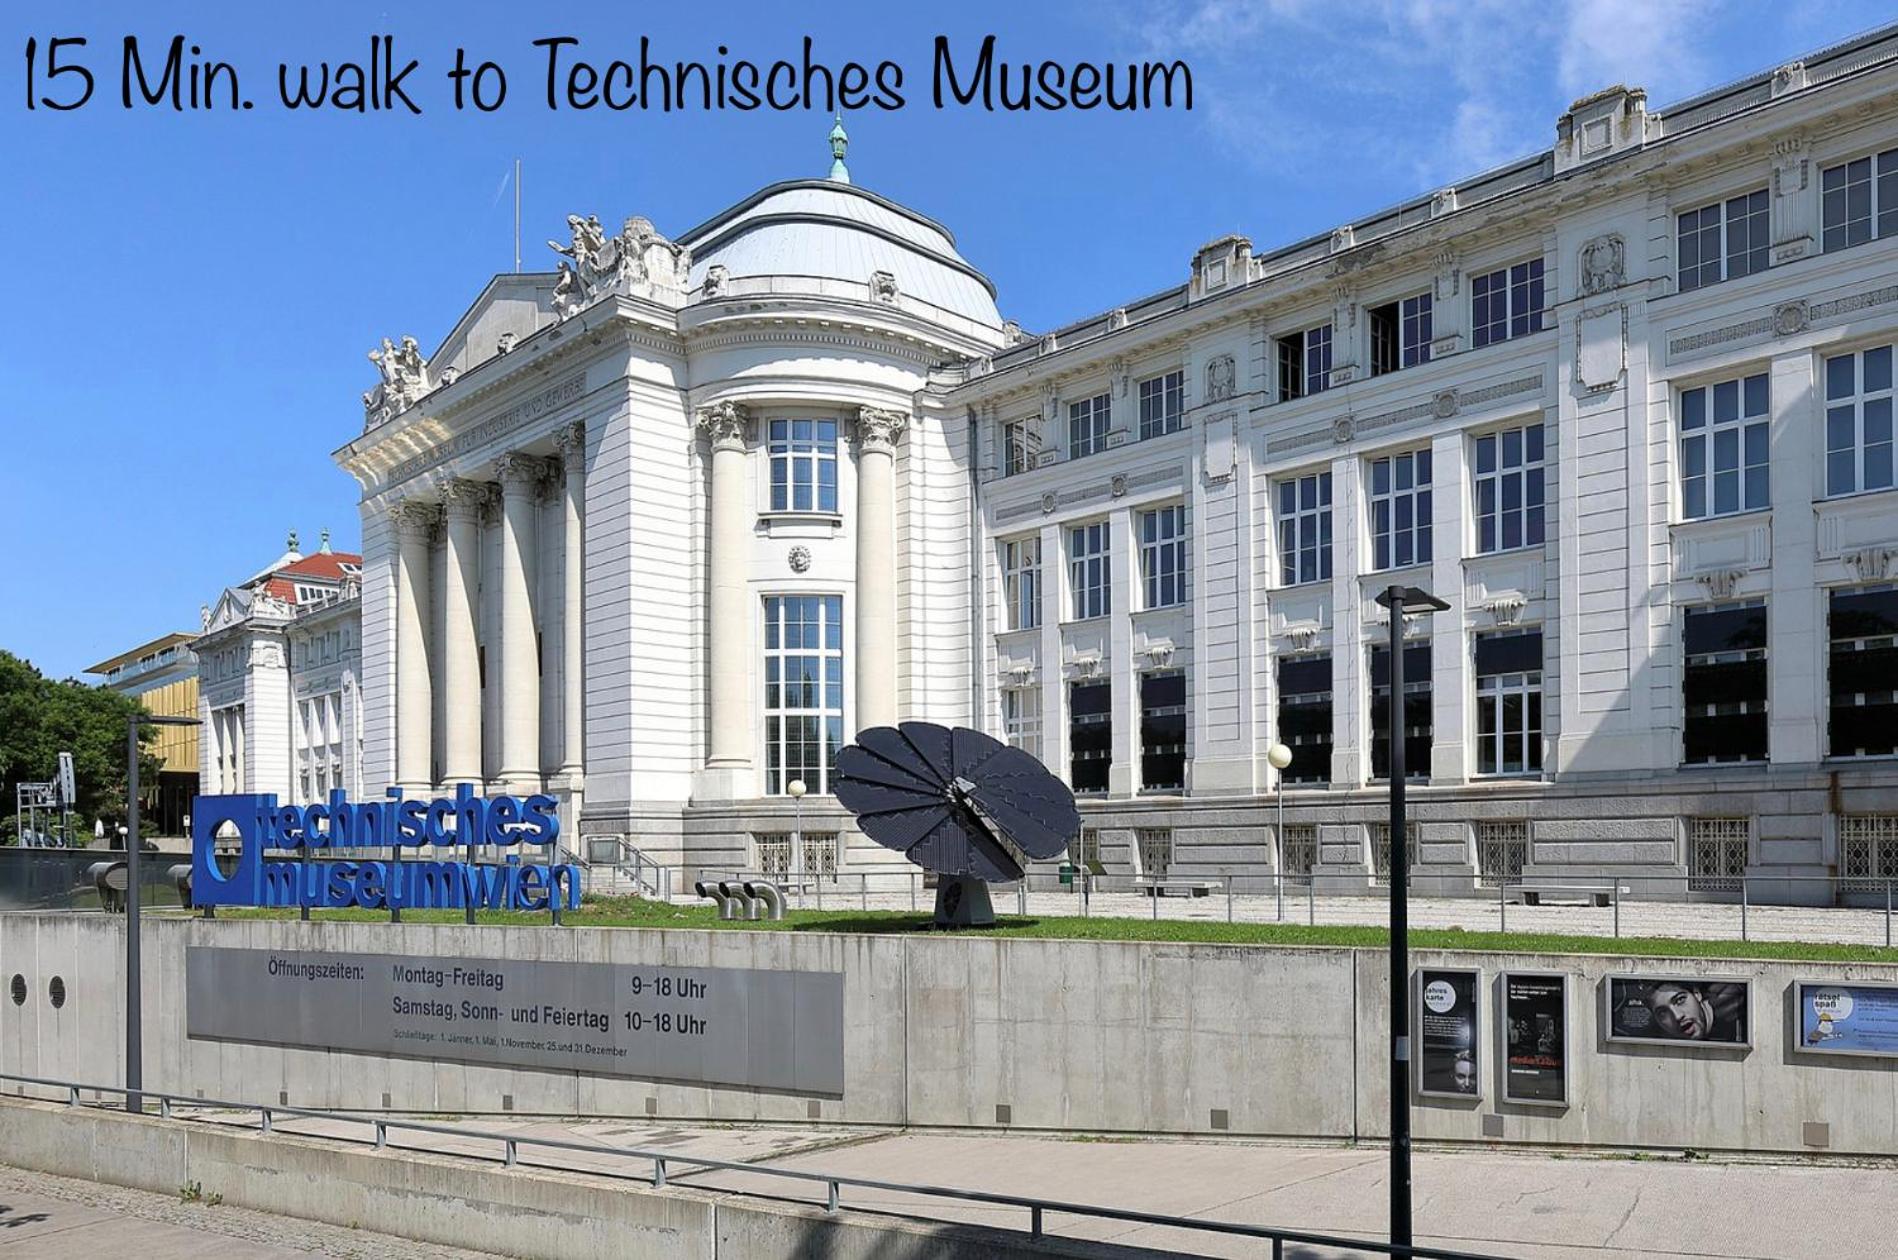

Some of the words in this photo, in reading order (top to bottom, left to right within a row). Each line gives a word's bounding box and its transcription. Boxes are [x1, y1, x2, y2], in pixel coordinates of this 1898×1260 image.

[257, 783, 560, 849] technisches
[268, 955, 364, 981] Öffnungszeiten:
[631, 975, 672, 997] 9-18
[676, 977, 707, 999] Uhr
[392, 995, 457, 1021] Samstag,
[460, 999, 504, 1021] Sonn-
[511, 1004, 539, 1024] und
[543, 1005, 609, 1033] Feiertag
[624, 1011, 672, 1033] 10-18
[676, 1013, 707, 1035] Uhr
[585, 1043, 628, 1057] Dezember
